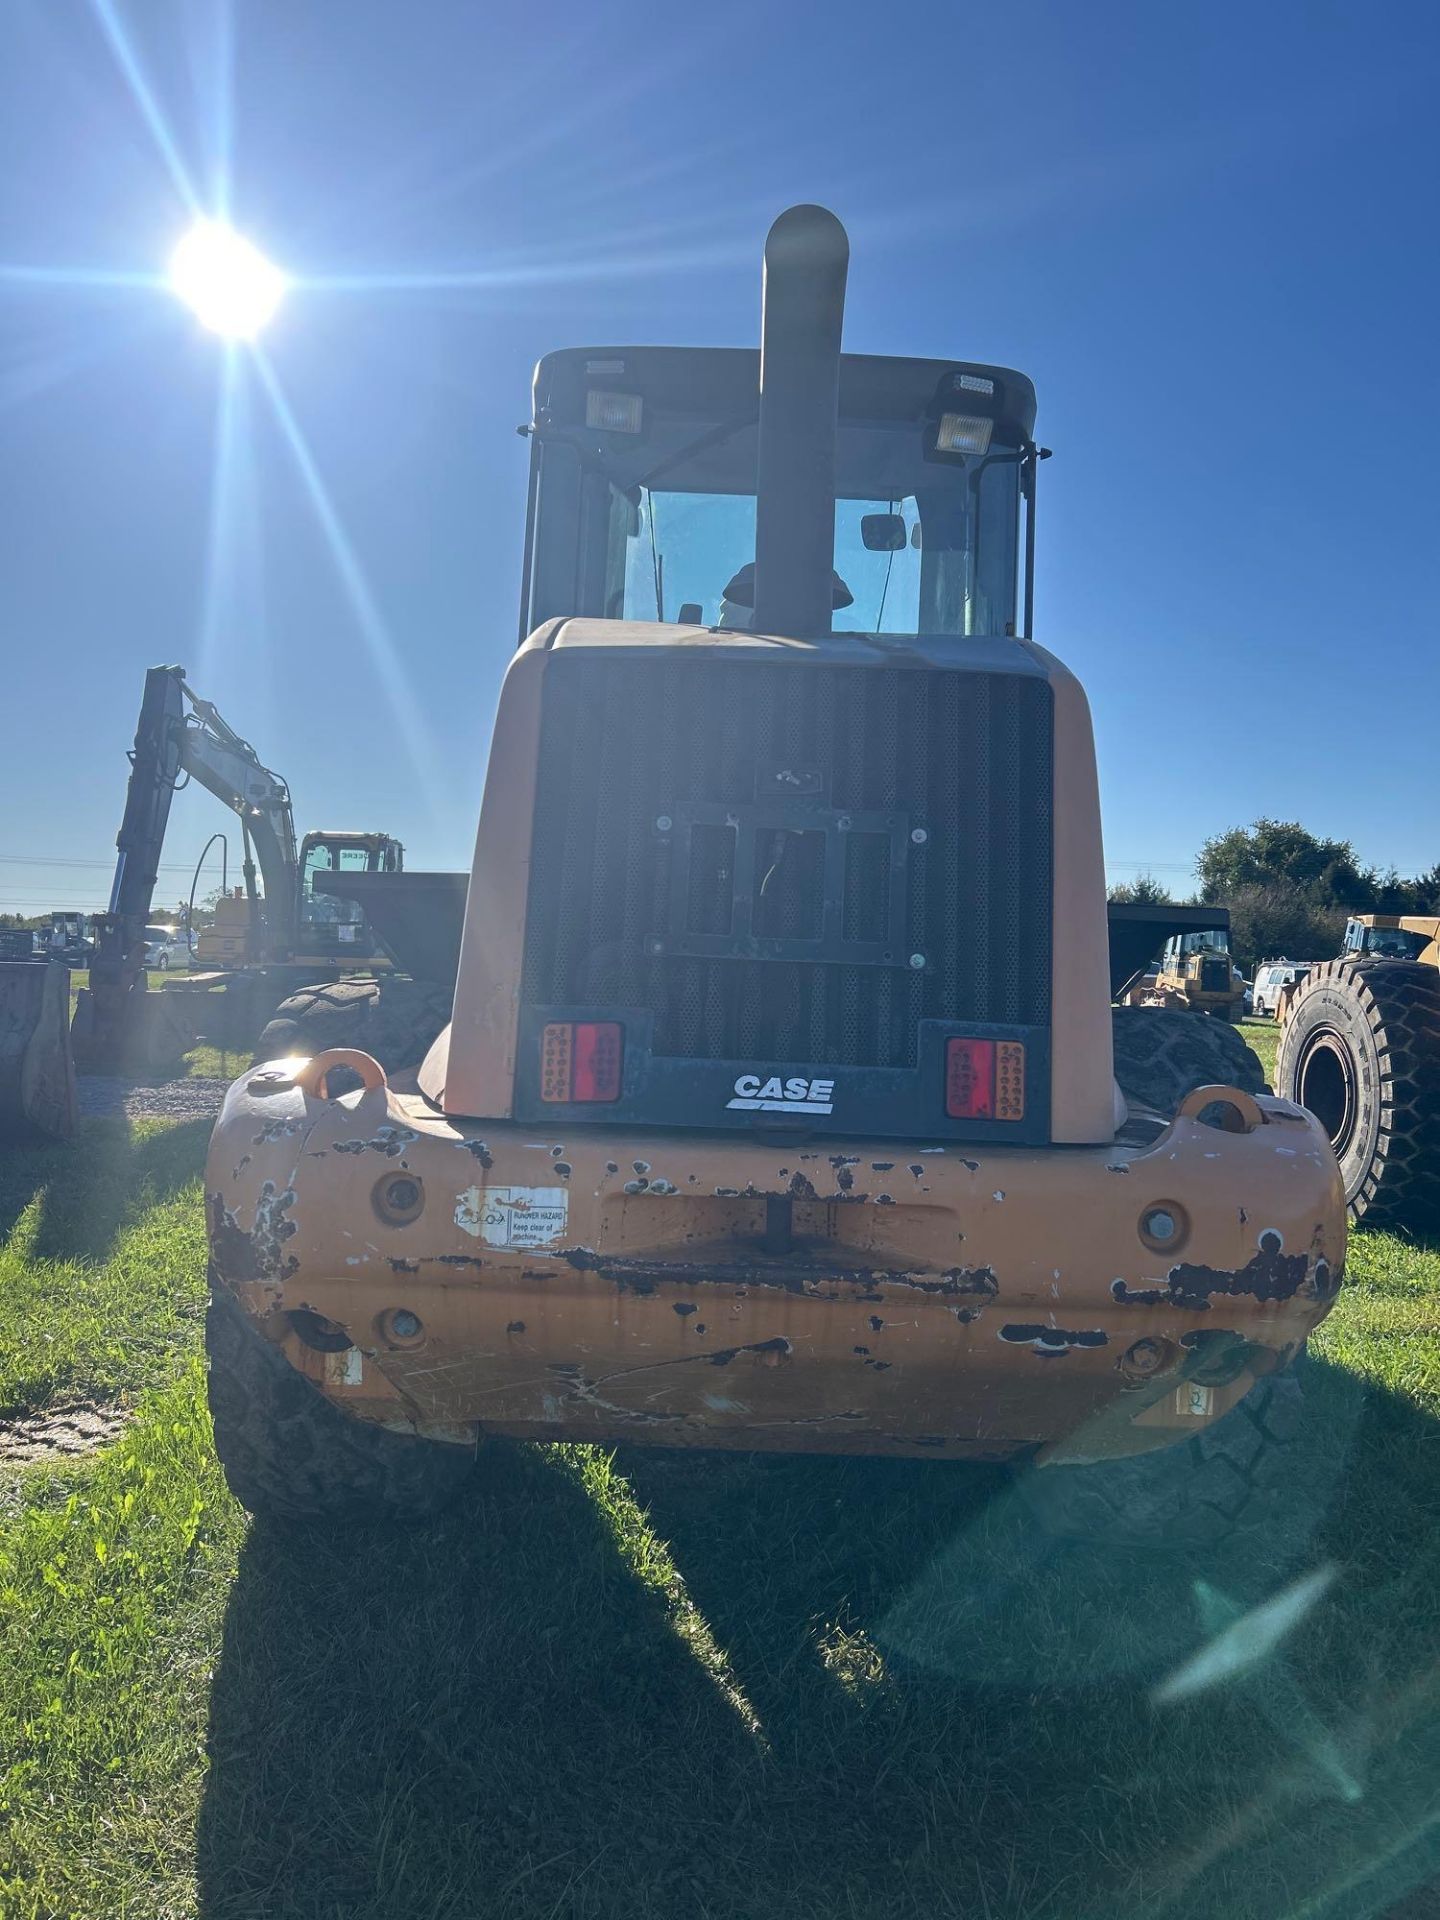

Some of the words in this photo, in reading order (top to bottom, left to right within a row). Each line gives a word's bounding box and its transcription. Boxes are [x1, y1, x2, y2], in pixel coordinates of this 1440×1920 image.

[733, 1074, 835, 1101] CASE
[541, 1211, 563, 1220] HAZARD
[513, 1224, 528, 1232] Keep
[530, 1223, 545, 1231] clear
